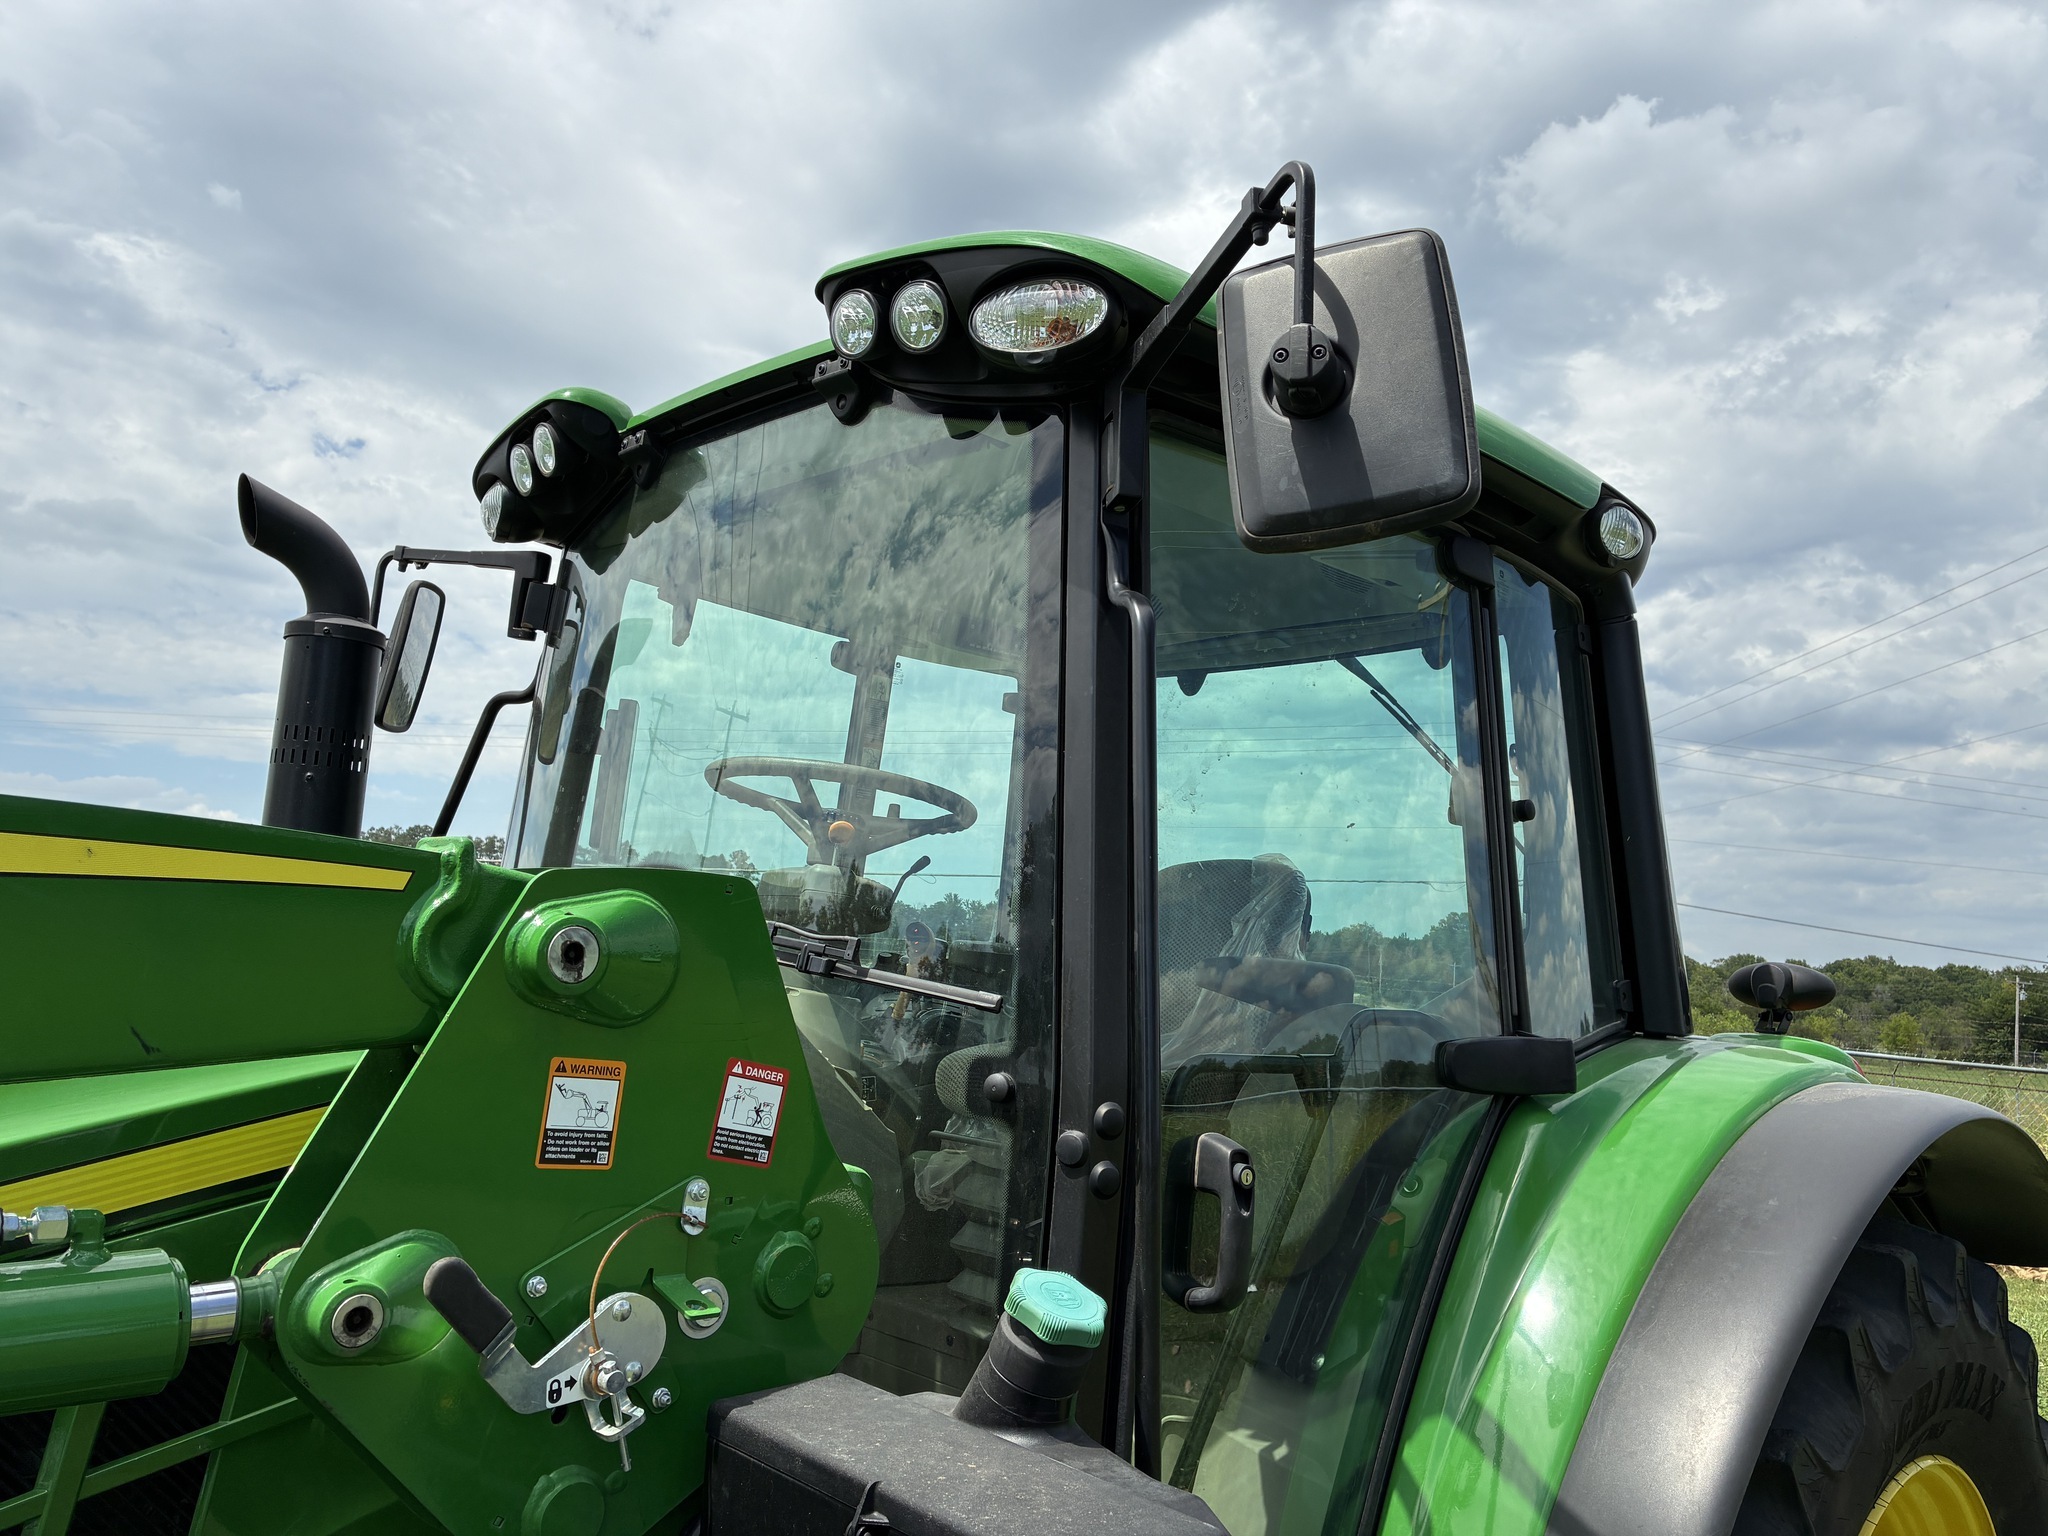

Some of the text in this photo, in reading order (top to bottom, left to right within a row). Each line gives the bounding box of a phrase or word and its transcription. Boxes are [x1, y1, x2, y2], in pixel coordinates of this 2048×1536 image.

[570, 1064, 621, 1077] WARNING
[745, 1066, 784, 1083] DANGER
[745, 1134, 758, 1142] injury
[728, 1144, 745, 1152] contact
[738, 1140, 766, 1149] electrocution.
